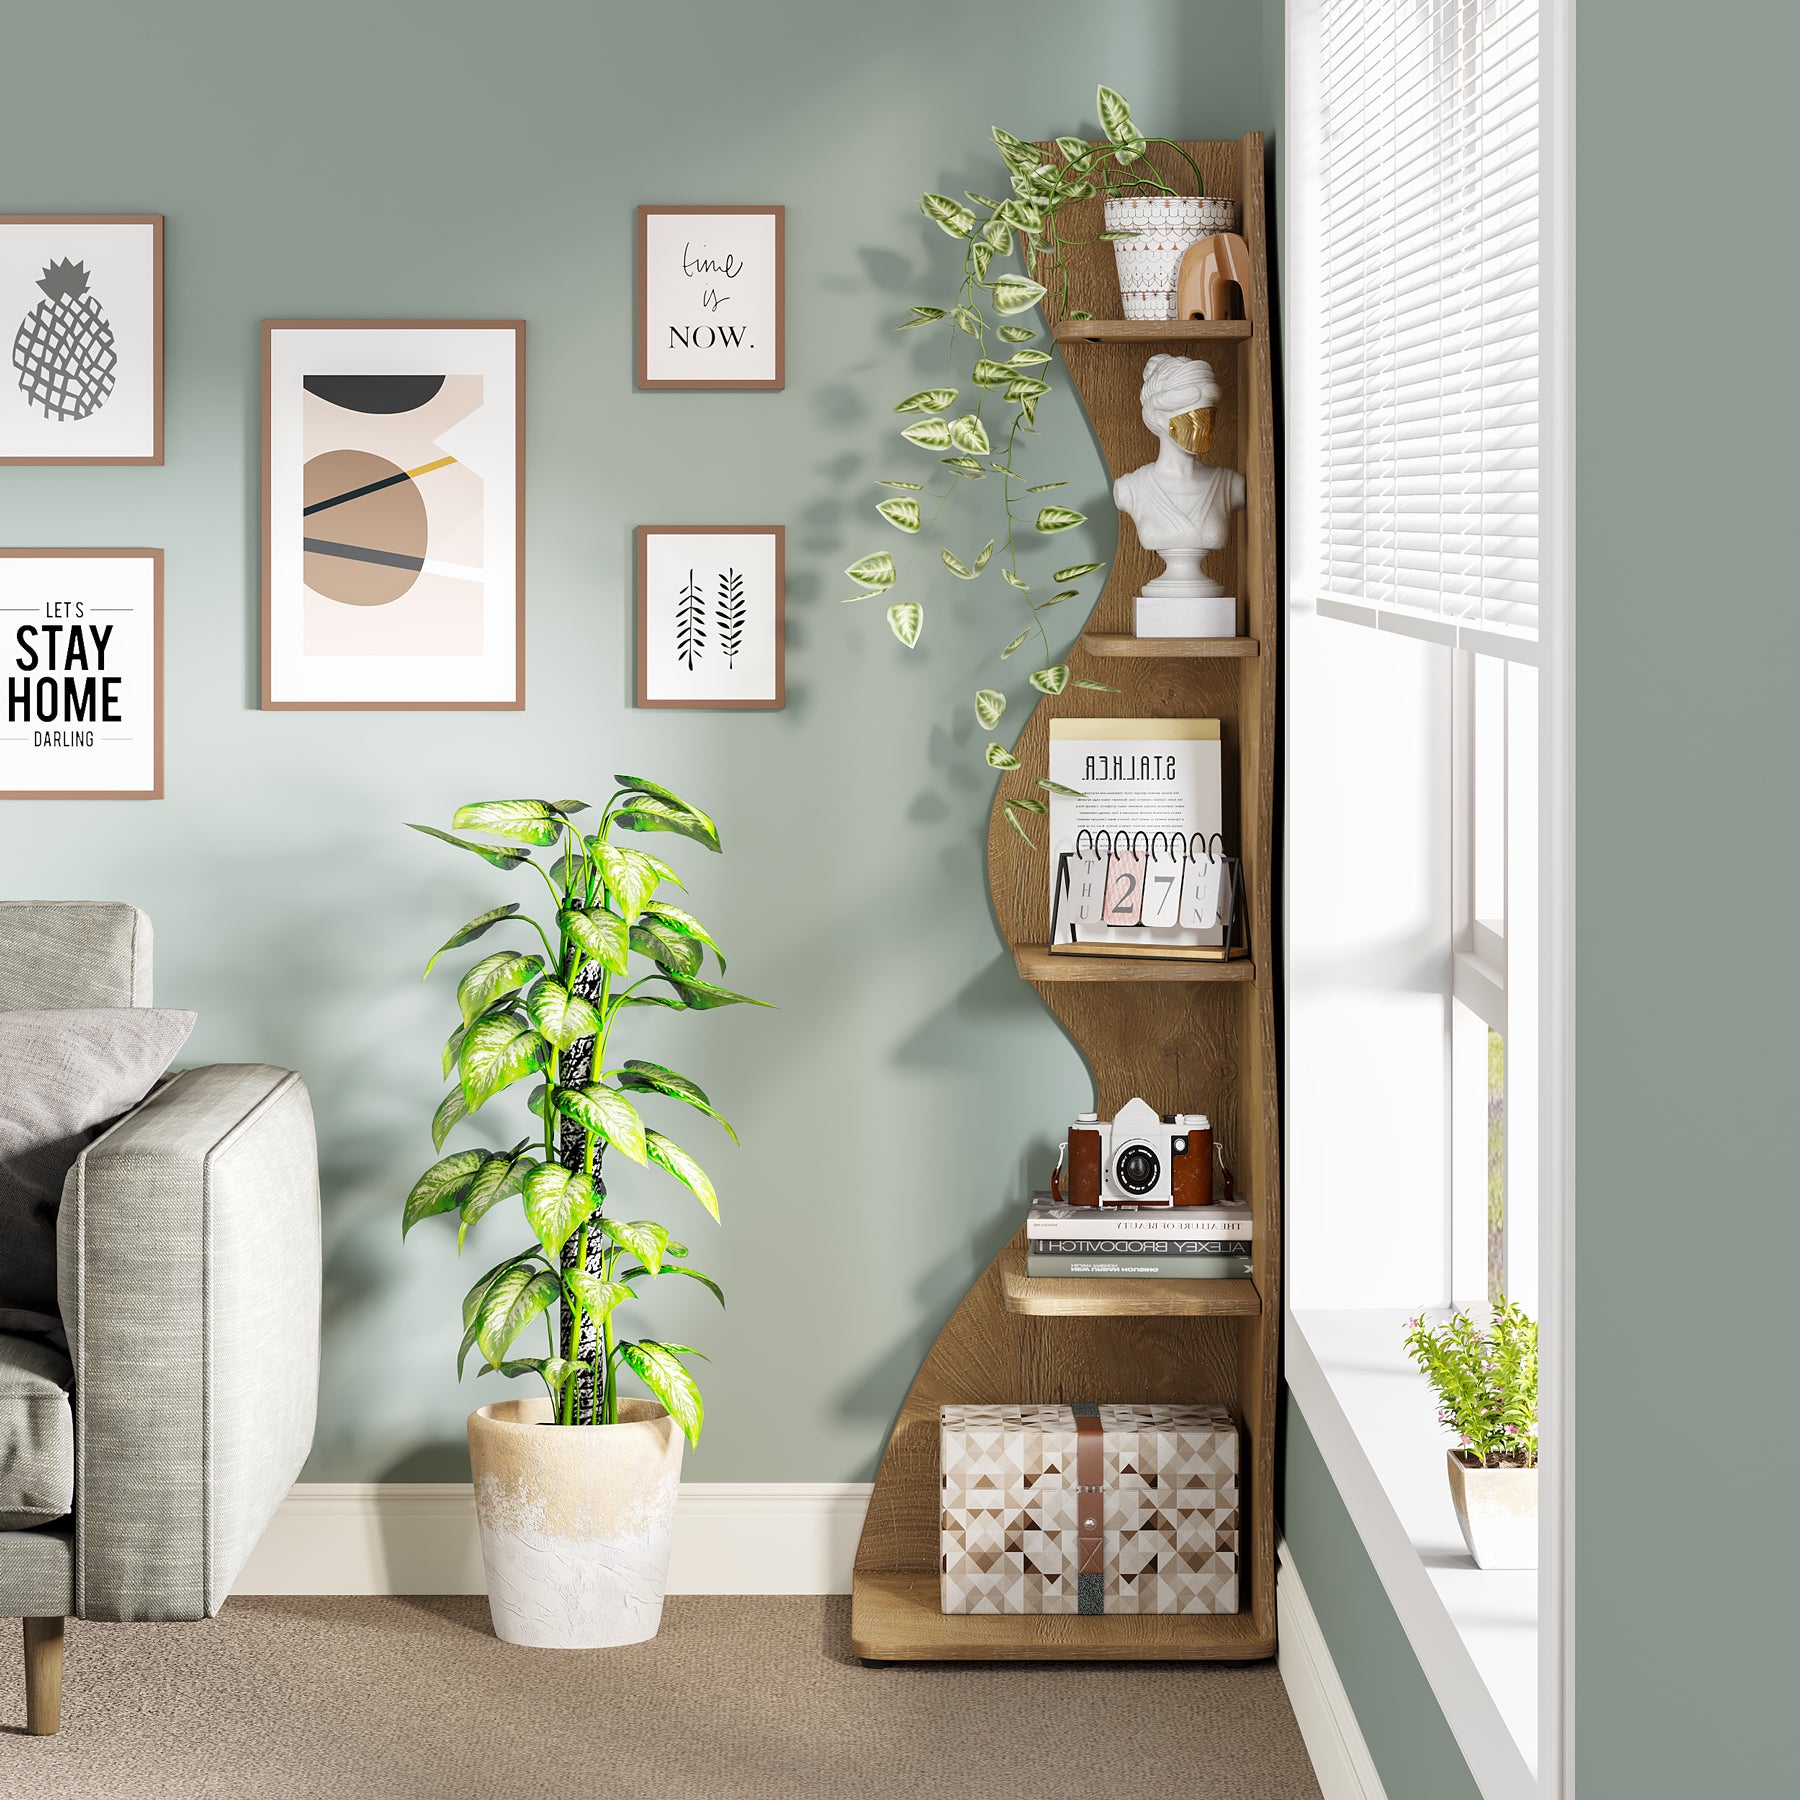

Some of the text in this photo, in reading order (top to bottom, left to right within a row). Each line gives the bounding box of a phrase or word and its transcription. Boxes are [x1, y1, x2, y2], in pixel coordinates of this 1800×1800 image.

[682, 241, 744, 279] time
[703, 282, 730, 312] is
[668, 325, 755, 349] NOW.
[46, 601, 84, 618] LET'S
[16, 624, 114, 672] STAY
[8, 676, 122, 723] HOME
[34, 730, 94, 747] DARLING
